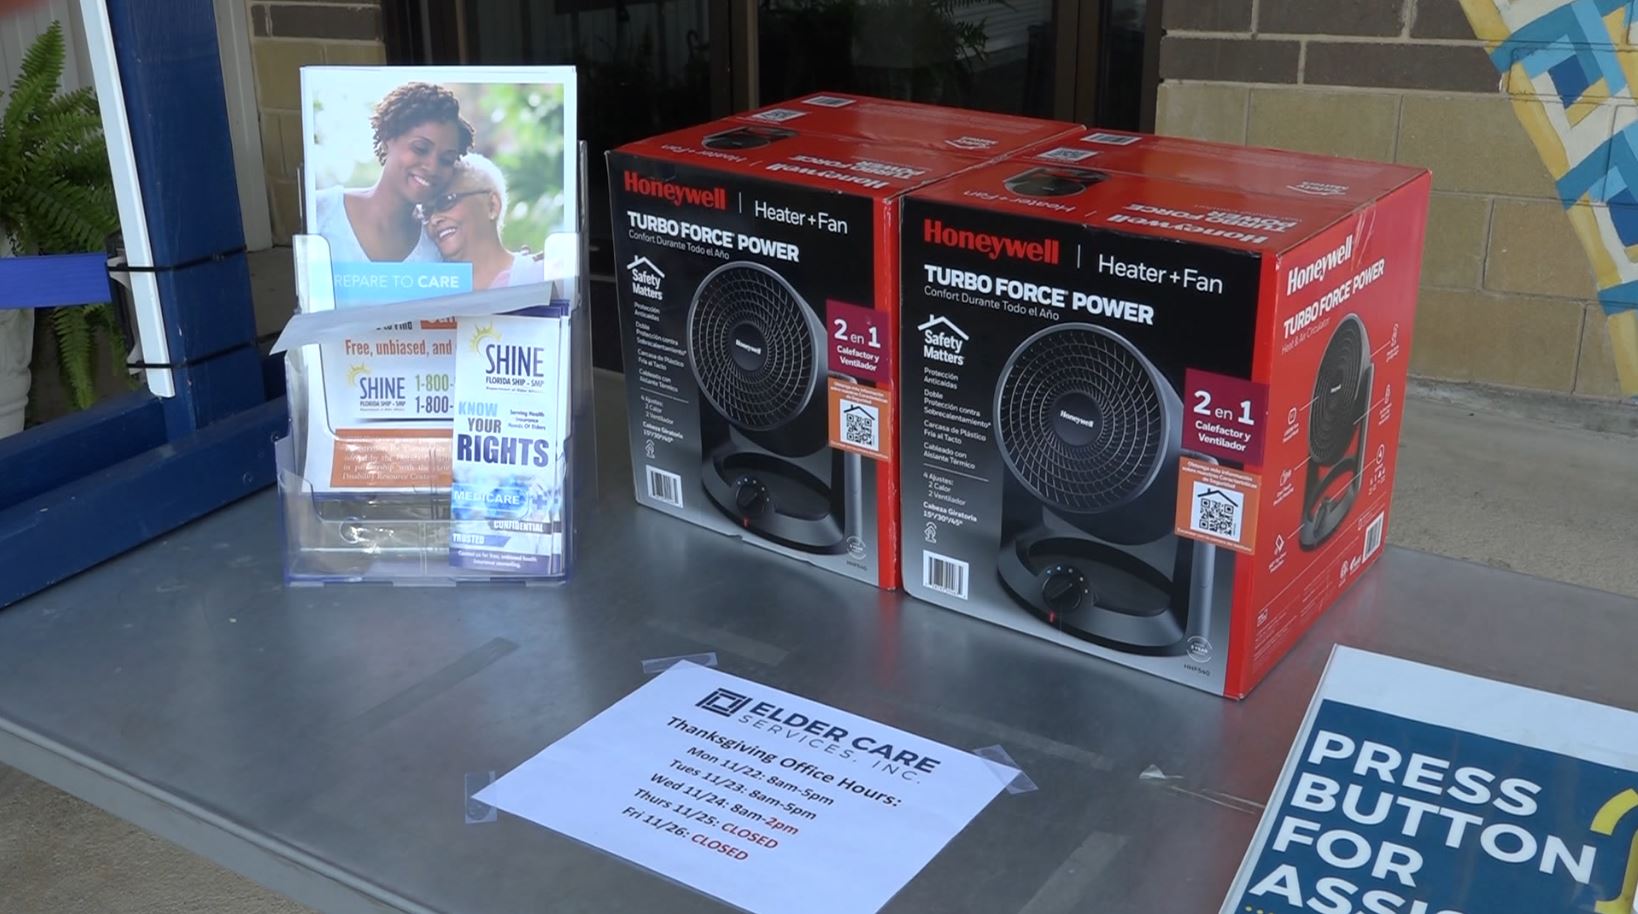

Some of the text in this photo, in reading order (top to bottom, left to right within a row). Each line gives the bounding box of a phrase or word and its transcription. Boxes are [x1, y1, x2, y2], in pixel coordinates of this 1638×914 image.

[766, 163, 888, 189] Honeywell
[624, 170, 727, 210] Honeywell
[627, 211, 800, 262] TURBO FORCE POWER
[1107, 214, 1269, 244] Honeywell
[628, 229, 655, 244] Confort
[656, 234, 686, 250] Durante
[687, 241, 705, 255] Todo
[706, 246, 714, 256] el
[923, 218, 1060, 265] Honeywell
[1286, 234, 1353, 296] Honeywell
[334, 274, 459, 288] REPARE TO CARE
[632, 268, 661, 290] Safety
[632, 282, 663, 300] Matters
[924, 264, 1154, 325] TURBO FORCE POWER
[1283, 258, 1385, 339] TURBO FORCE POWER
[924, 285, 1060, 321] Confort Durante Todo el Año
[833, 318, 881, 349] 2 en 1
[924, 329, 963, 354] Safety
[345, 339, 453, 357] Free, unbiased, and
[836, 345, 874, 361] Calefactor
[923, 345, 964, 366] Matters
[485, 344, 544, 377] SHINE
[839, 356, 877, 372] Ventilador
[360, 377, 405, 400] SHINE
[415, 374, 454, 392] 1-800-
[486, 376, 511, 386] FLORIDA
[415, 396, 454, 414] 1-800-
[924, 388, 944, 400] Doble
[458, 401, 498, 417] KNOW
[959, 406, 981, 417] contra
[1193, 390, 1255, 426] 2 en 1
[468, 417, 502, 434] YOUR
[924, 420, 950, 432] Carcasa
[1195, 420, 1251, 443] Calefactor y
[944, 433, 962, 445] Tacto
[1198, 433, 1247, 452] Ventilador
[457, 434, 549, 468] RIGHTS
[955, 451, 967, 459] con
[454, 490, 520, 505] MEDICARE
[933, 482, 952, 492] Calor
[923, 501, 978, 522] Cabeza Giratoria
[494, 520, 544, 532] CONFIDENTIAL
[453, 533, 485, 545] TRUSTED
[749, 701, 942, 774] ELDER CARE
[667, 716, 903, 807] Thanksgiving Office Hours:
[872, 761, 921, 784] INC.
[1307, 729, 1542, 817] PRESS
[687, 746, 835, 808] Mon 11/22: 8am-5pm
[669, 759, 817, 822] Tues 11/23: 8am-5pm
[651, 773, 799, 836] Wed 11/24: 8am-2pm
[633, 788, 779, 850] Thurs 11/25: CLOSED
[1290, 771, 1597, 885] BUTTON
[622, 806, 749, 862] Fri 11/26: CLOSED
[1272, 815, 1424, 888] FOR
